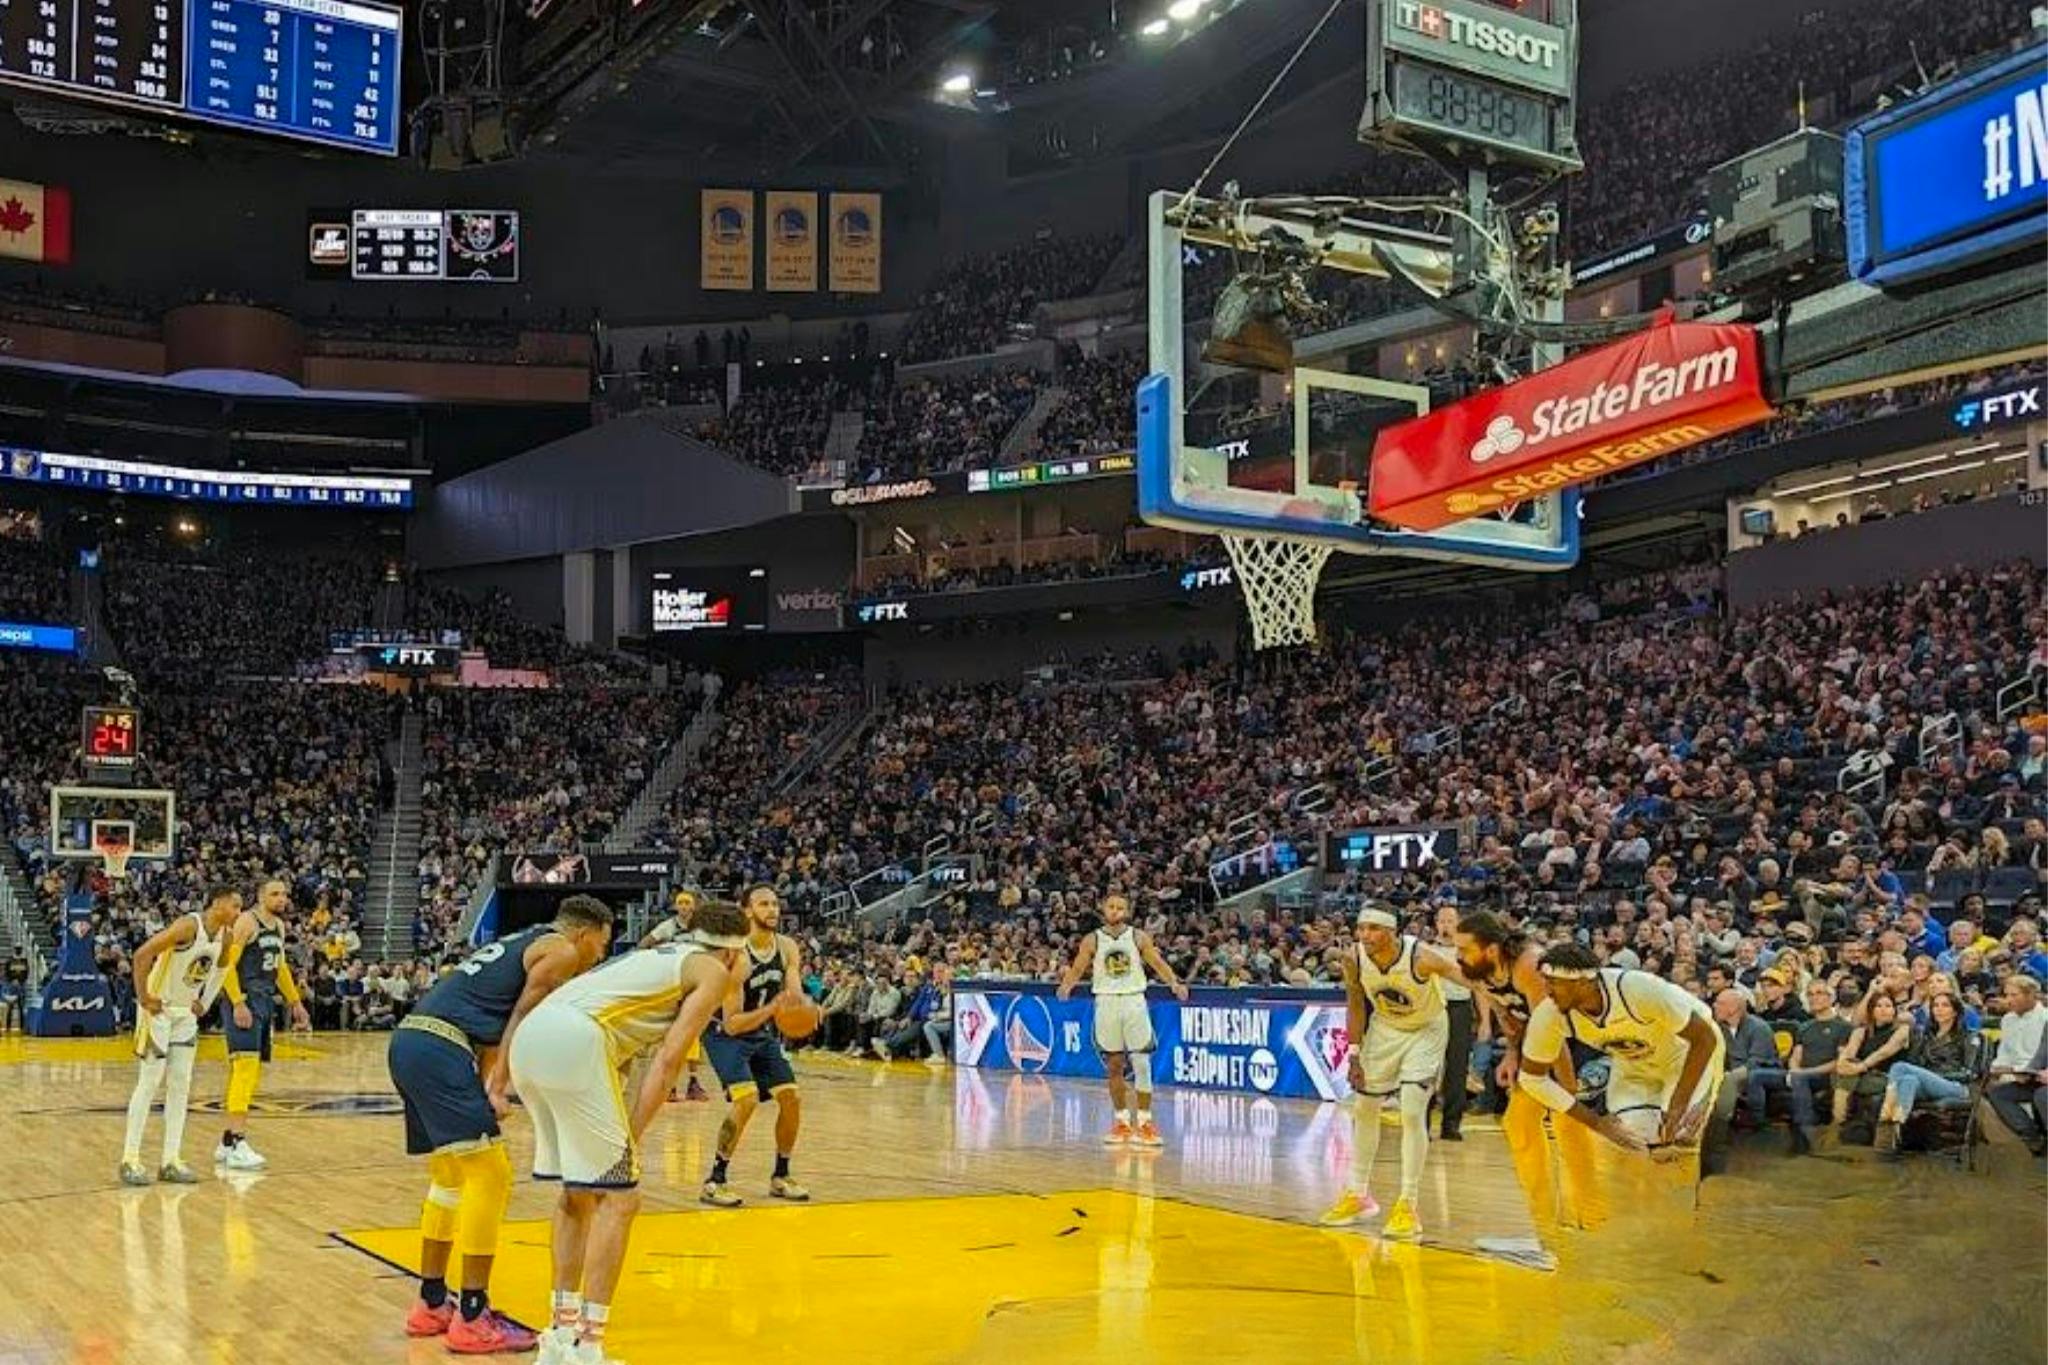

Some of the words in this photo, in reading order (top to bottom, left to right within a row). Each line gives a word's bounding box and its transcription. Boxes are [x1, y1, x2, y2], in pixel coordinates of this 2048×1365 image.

[1443, 14, 1560, 68] TISSOT
[30, 60, 56, 77] 17.2
[270, 68, 278, 82] 7
[1983, 387, 2041, 423] FTX
[1197, 567, 1232, 589] FTX
[875, 601, 908, 621] FTX
[400, 648, 436, 665] FTX
[94, 727, 128, 752] 24
[1372, 831, 1440, 870] FTX
[943, 867, 966, 881] FTX
[1063, 1020, 1080, 1053] VS
[1180, 1006, 1271, 1048] WEDNESDAY
[1231, 1055, 1246, 1087] ET
